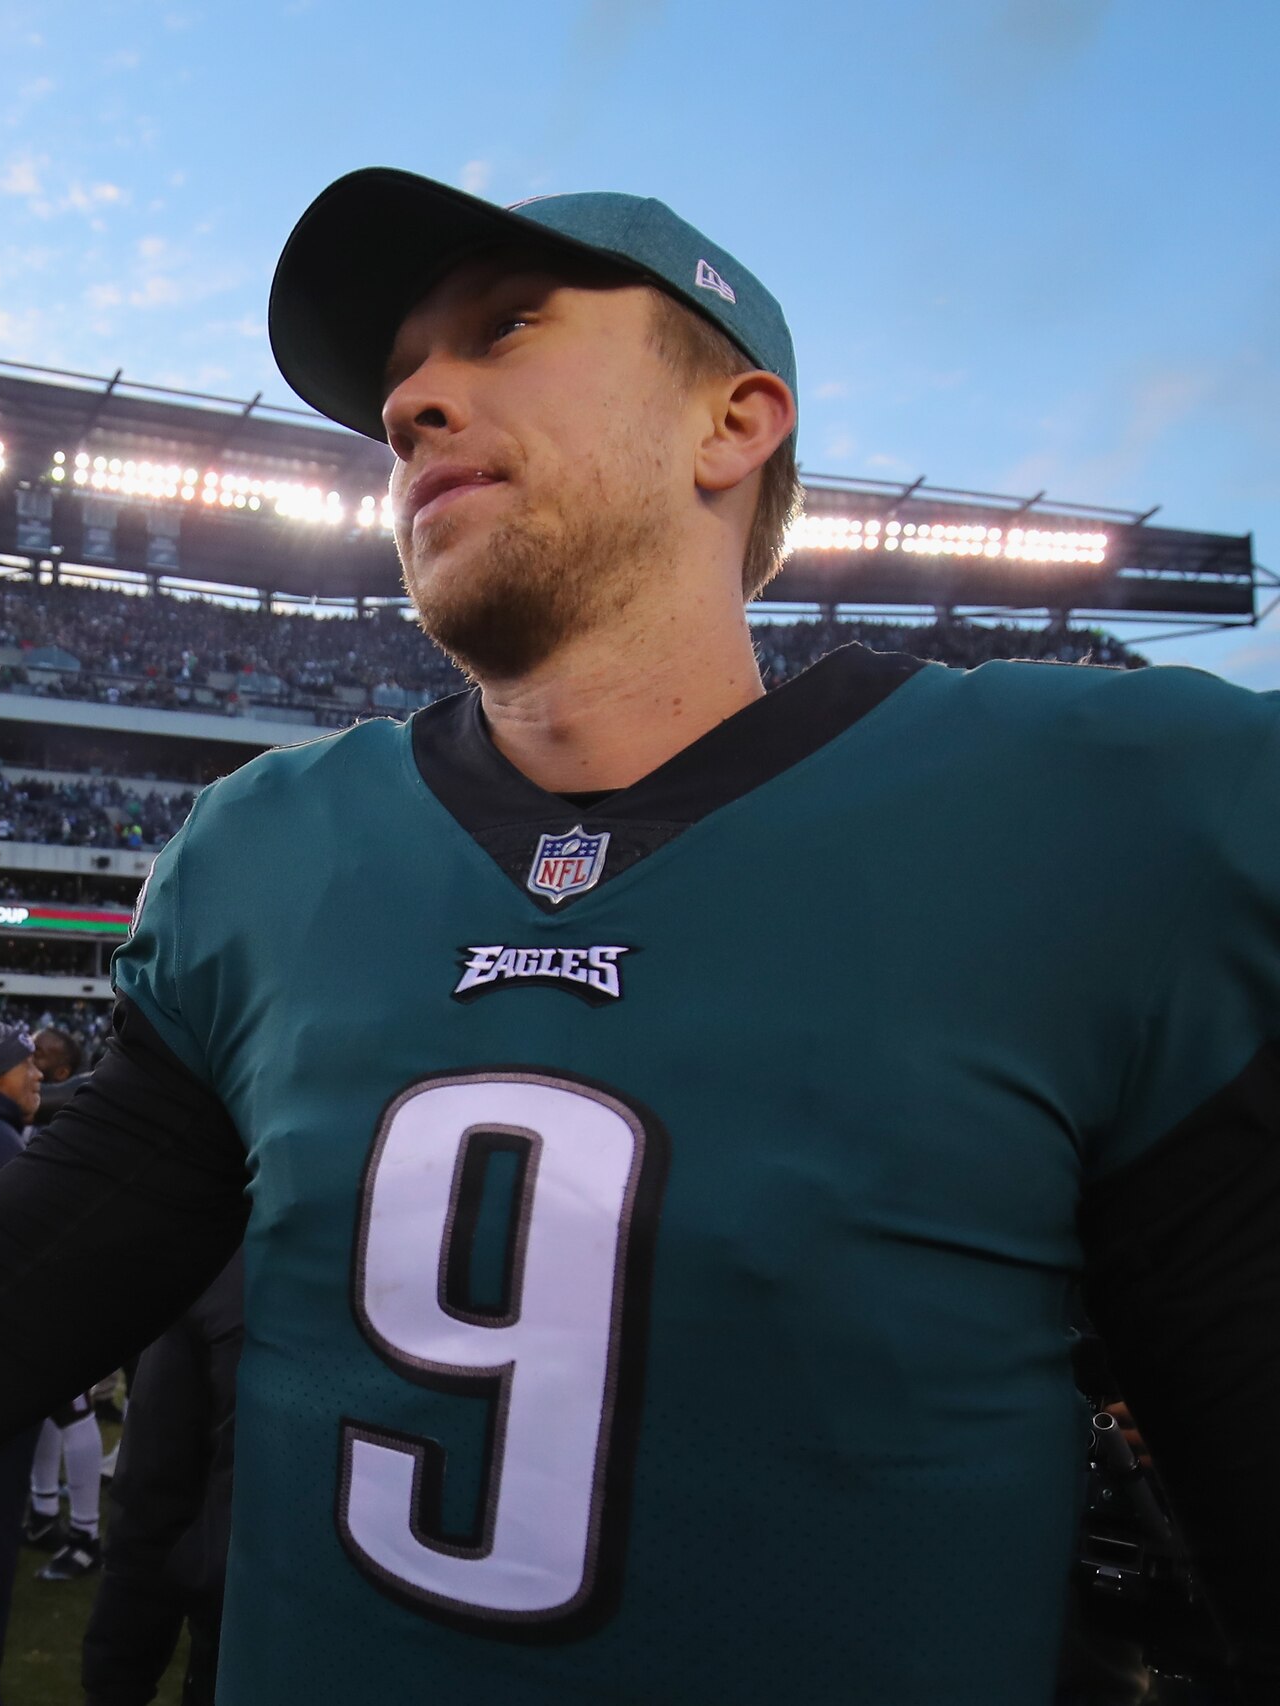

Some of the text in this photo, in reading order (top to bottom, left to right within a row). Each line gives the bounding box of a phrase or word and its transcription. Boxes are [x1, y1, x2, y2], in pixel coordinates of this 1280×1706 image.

[538, 858, 588, 888] NFL
[454, 945, 630, 998] EAGLES
[337, 1072, 642, 1622] 9
